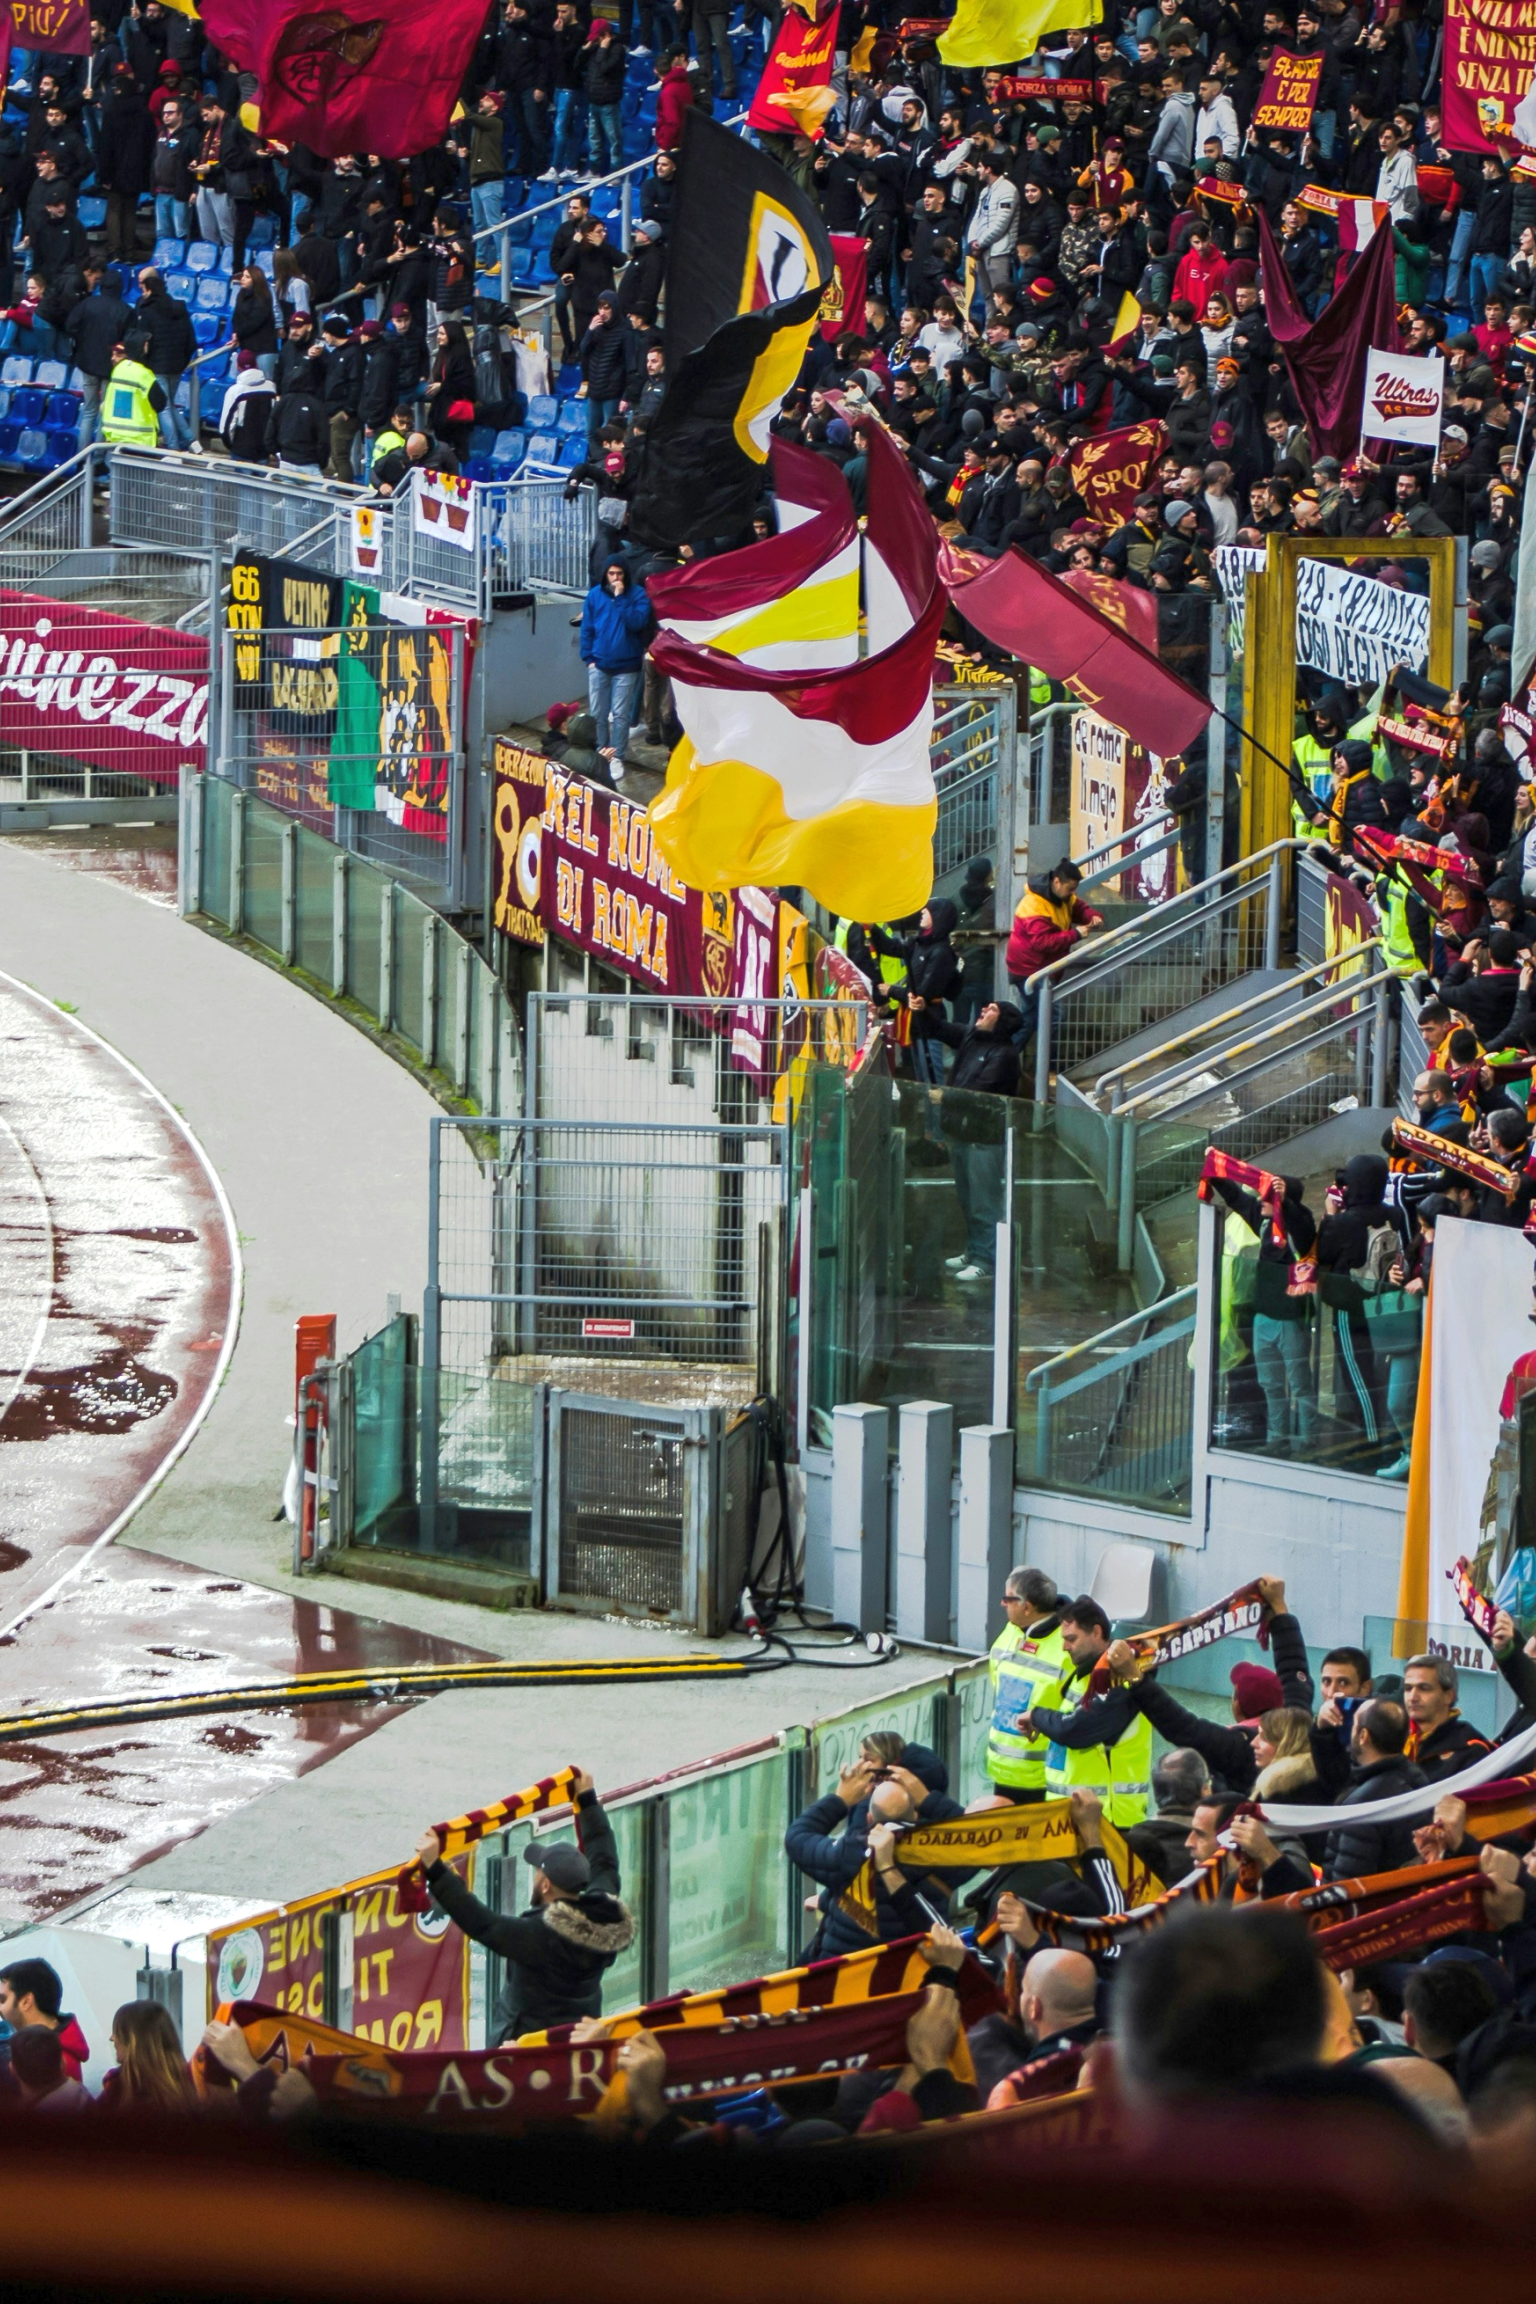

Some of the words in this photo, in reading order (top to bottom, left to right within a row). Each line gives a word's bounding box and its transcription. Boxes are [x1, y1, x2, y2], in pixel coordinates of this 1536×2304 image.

[1015, 82, 1047, 94] FORZA
[1057, 84, 1083, 95] ROMA
[1286, 82, 1311, 103] PER
[1456, 60, 1510, 94] SENZA
[1254, 105, 1312, 128] SEMPRE!
[1375, 372, 1434, 403] Ultras
[1384, 404, 1402, 414] AS
[232, 566, 260, 602] 66
[283, 577, 330, 628] ULTIMO
[1090, 723, 1122, 765] roma
[556, 856, 584, 934] DI
[592, 877, 669, 985] ROMA
